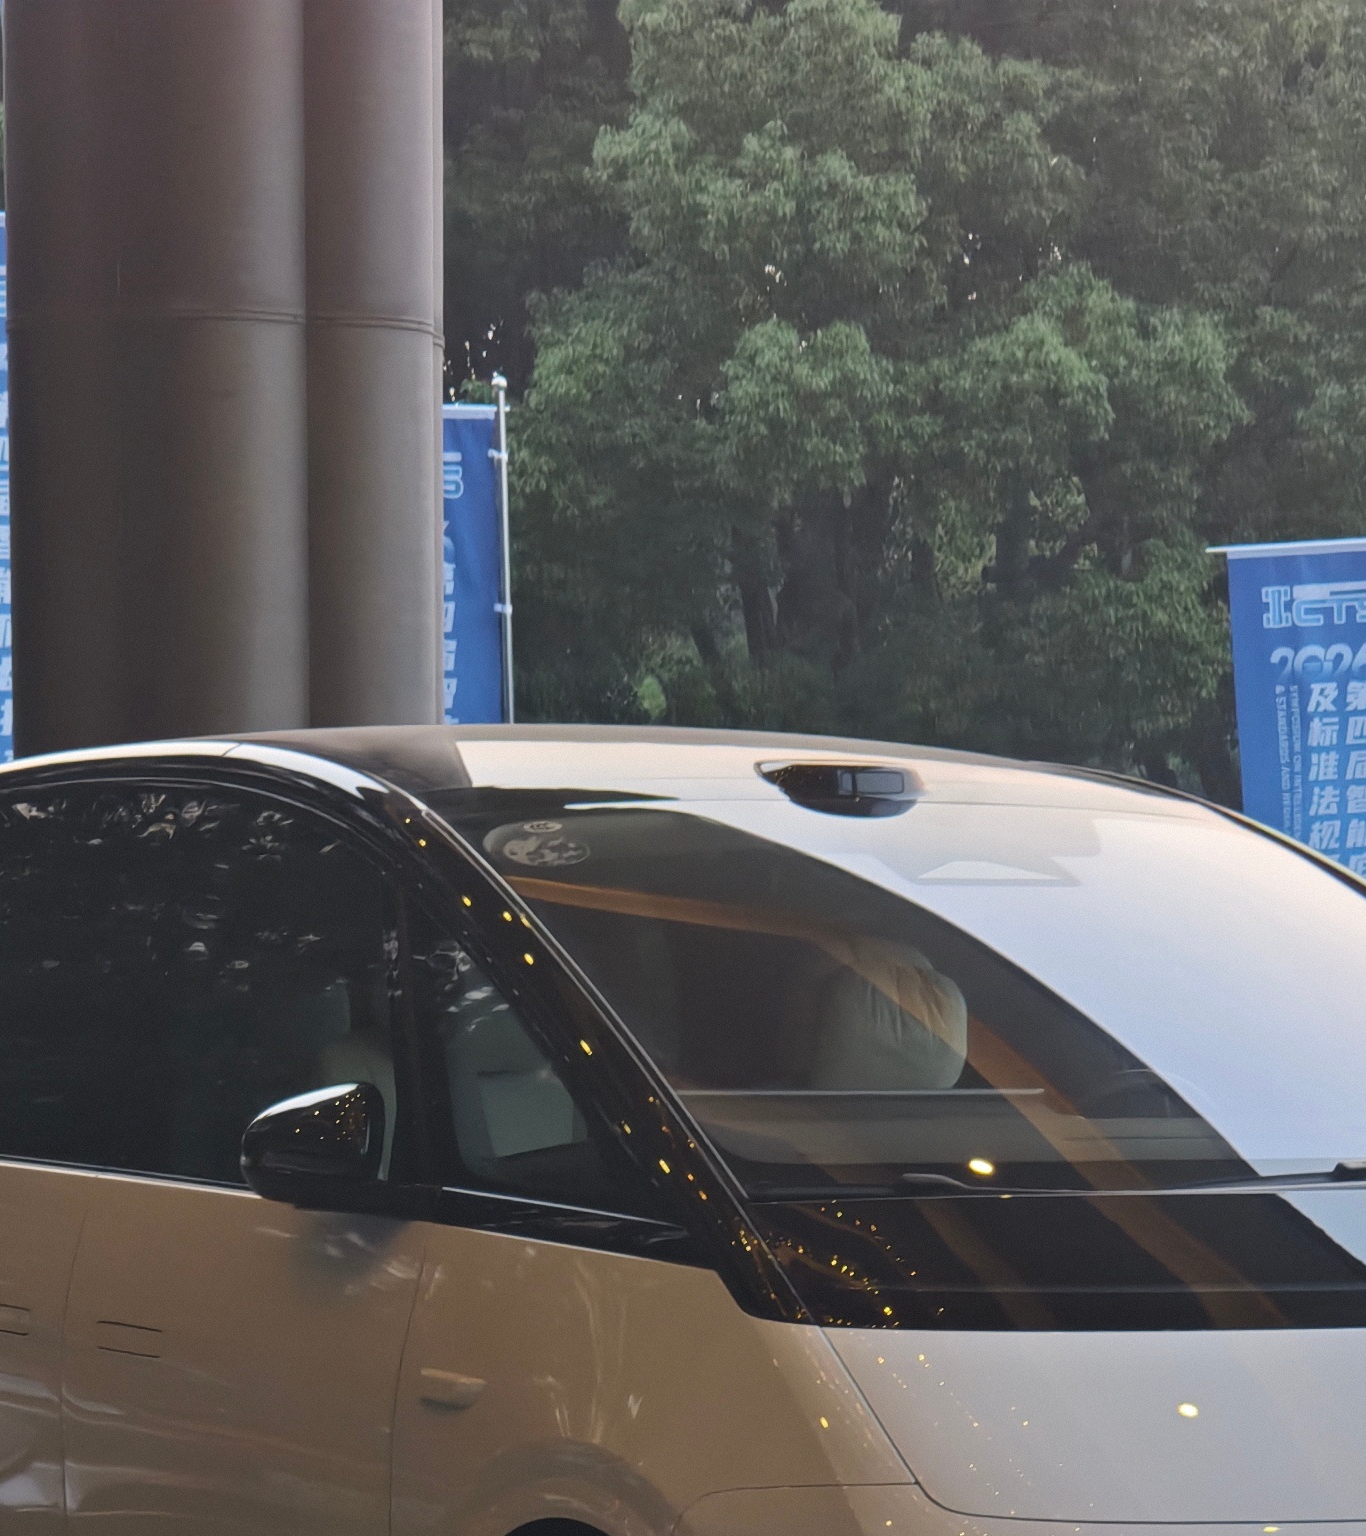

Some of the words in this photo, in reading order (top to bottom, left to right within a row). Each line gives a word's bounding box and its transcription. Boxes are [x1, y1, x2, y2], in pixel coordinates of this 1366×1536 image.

[1307, 681, 1341, 866] 及标准法规
